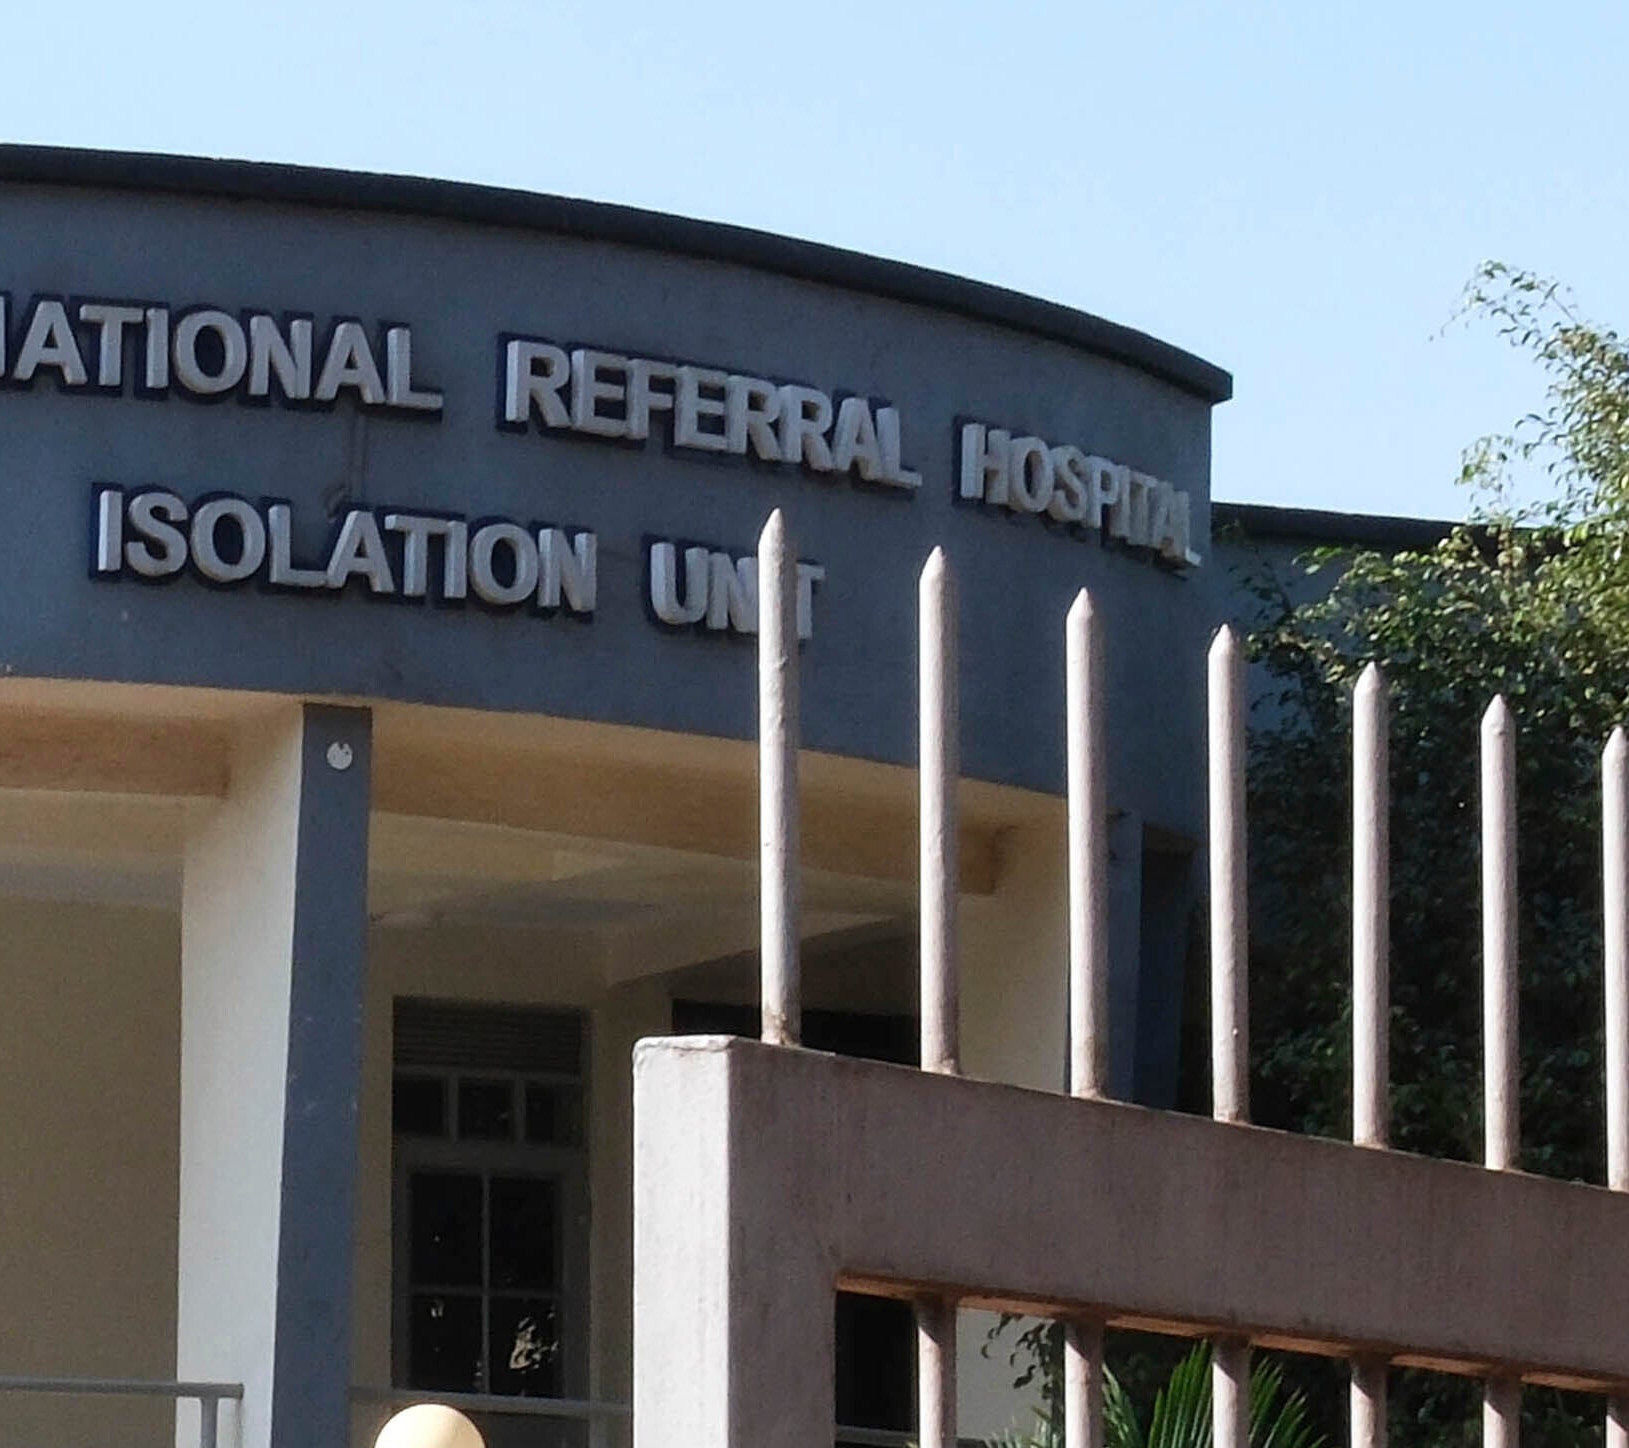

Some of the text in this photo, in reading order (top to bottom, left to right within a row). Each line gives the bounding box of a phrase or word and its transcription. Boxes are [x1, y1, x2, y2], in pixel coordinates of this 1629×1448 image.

[504, 338, 922, 490] REFERRAL
[959, 421, 1204, 568] HOSPITAL
[95, 488, 826, 640] ISOLATION UNT
